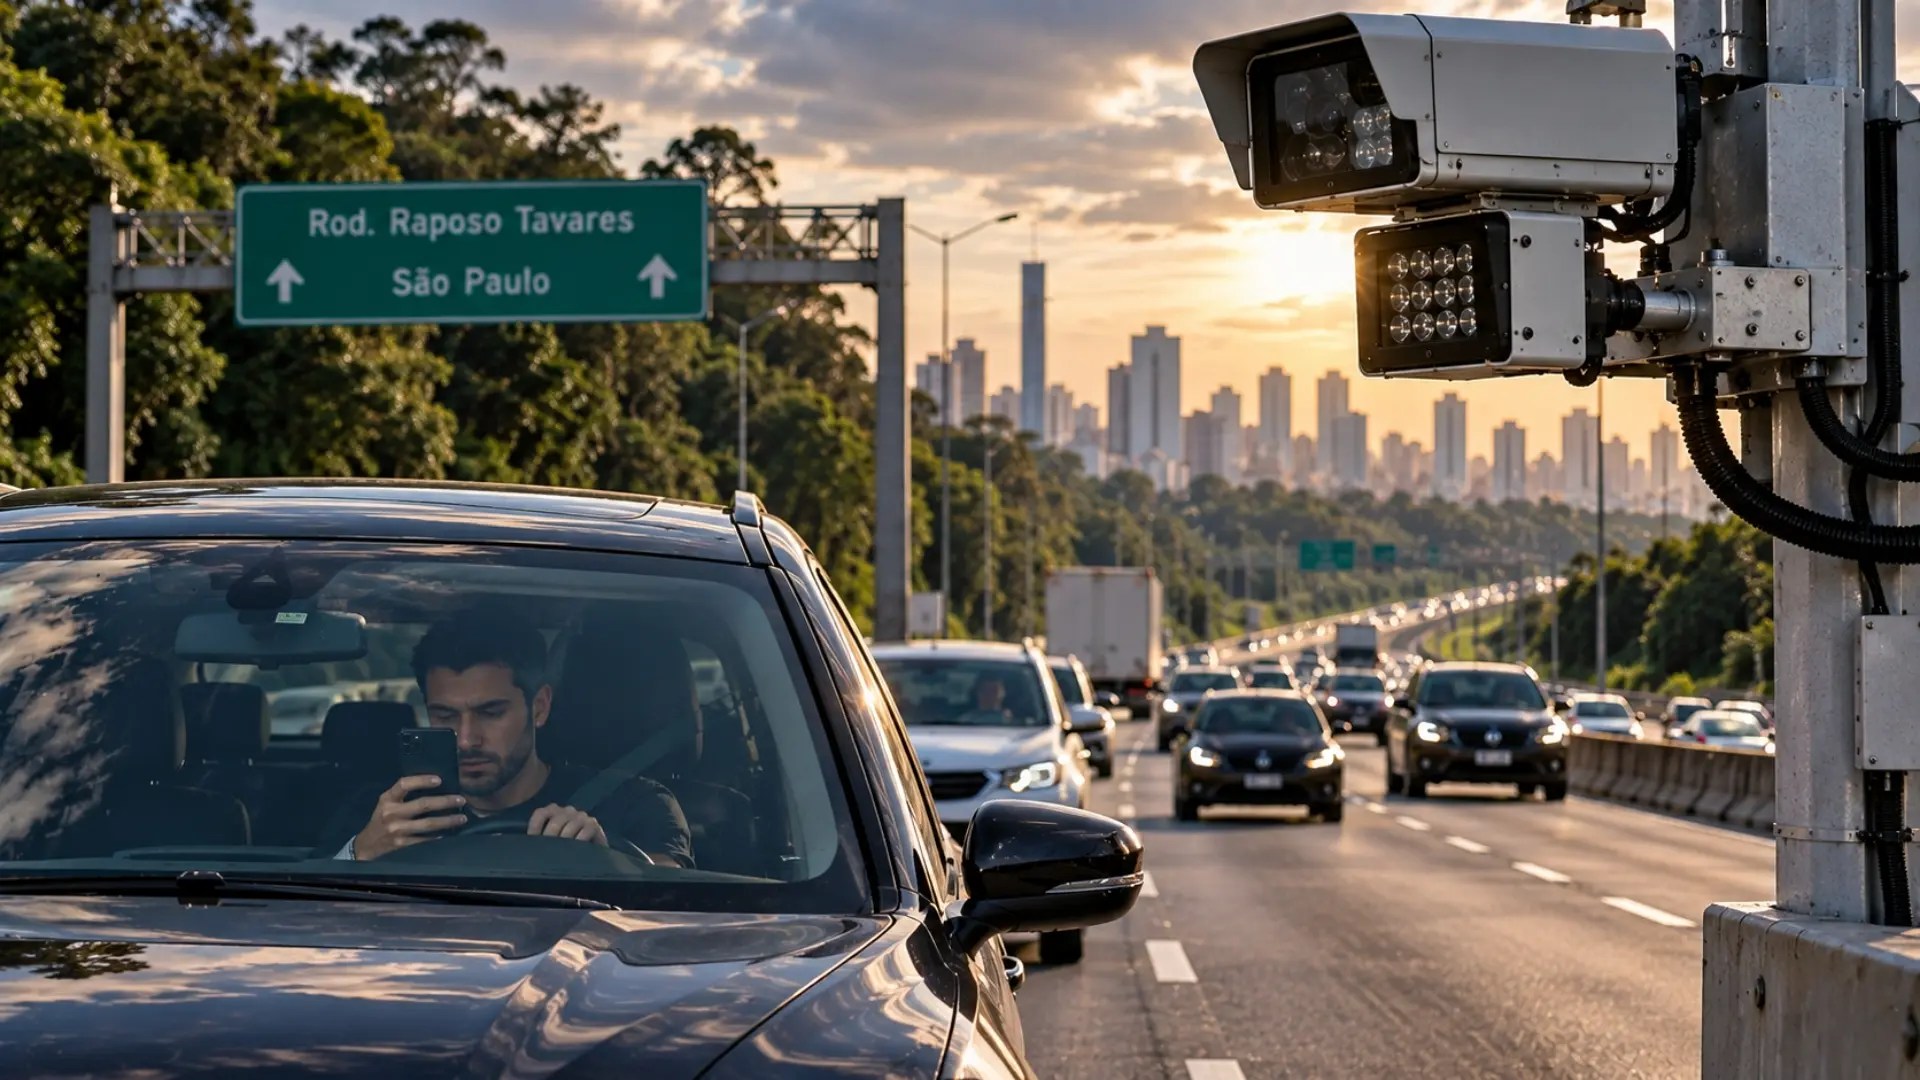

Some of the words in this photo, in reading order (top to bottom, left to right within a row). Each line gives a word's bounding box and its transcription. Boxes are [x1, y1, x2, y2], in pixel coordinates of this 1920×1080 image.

[309, 208, 375, 237] Rod.
[390, 207, 502, 241] Raposo
[515, 205, 635, 234] Tavares
[392, 267, 450, 297] São
[464, 266, 551, 296] Paulo
